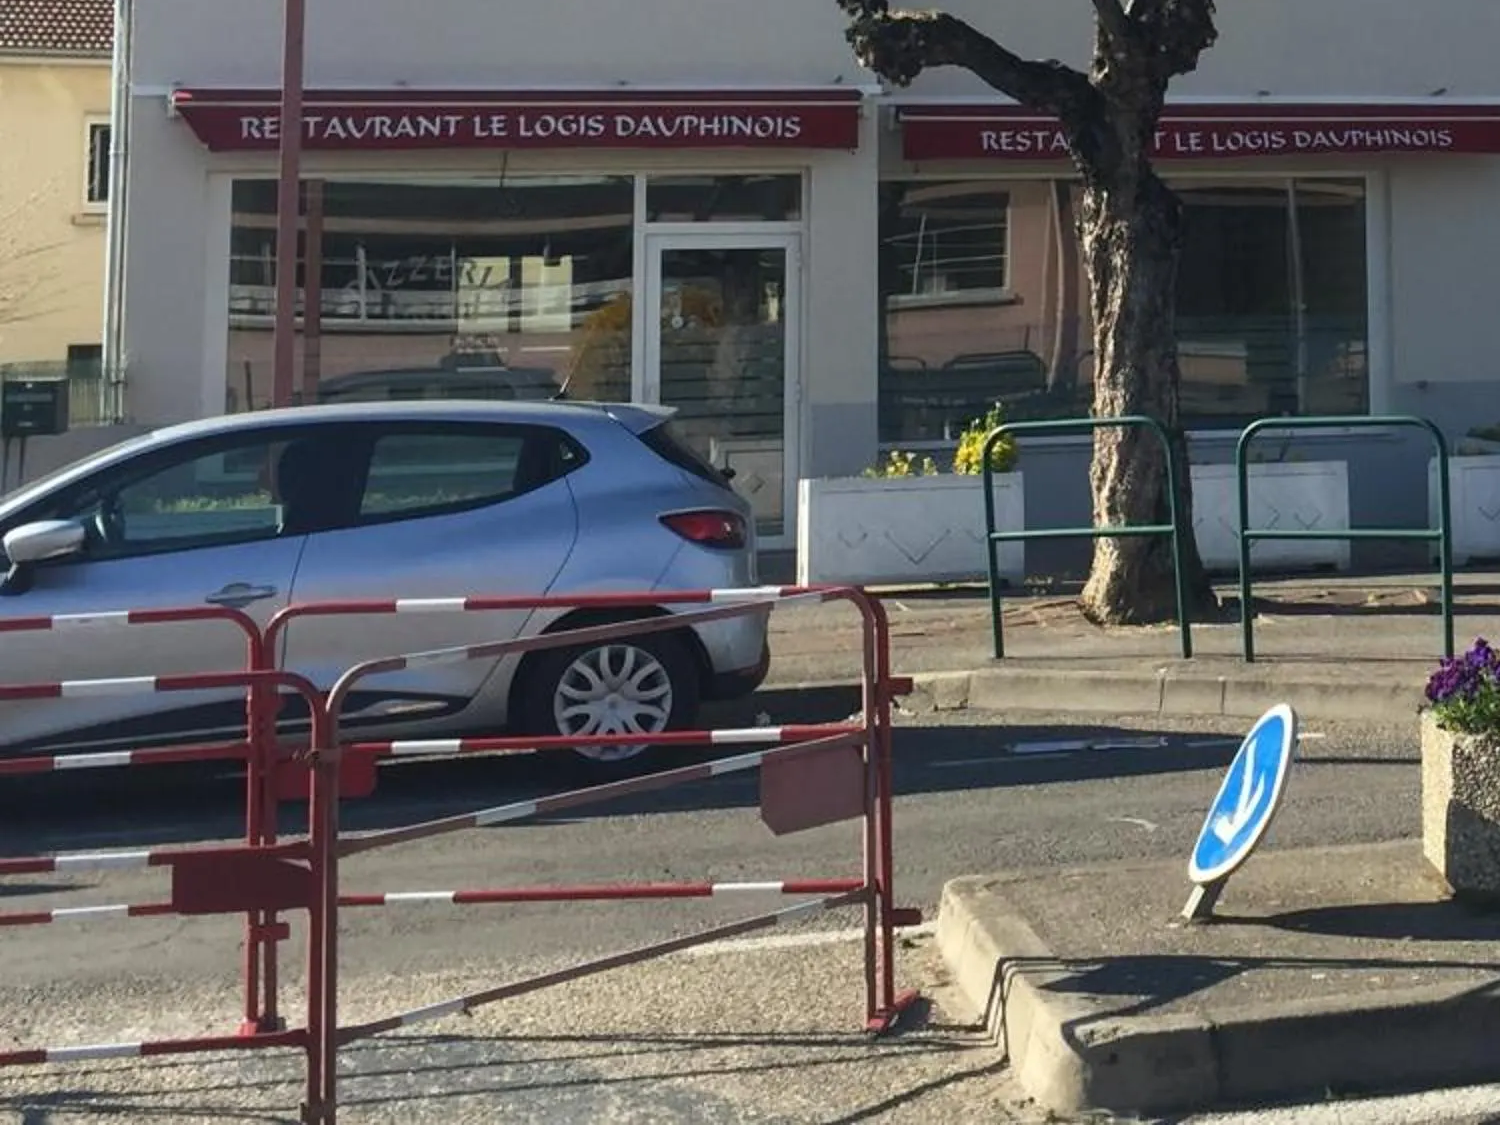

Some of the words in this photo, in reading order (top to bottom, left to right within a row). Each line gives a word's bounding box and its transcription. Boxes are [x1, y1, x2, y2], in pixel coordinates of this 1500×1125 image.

[240, 115, 464, 140] RETAURANT
[473, 115, 508, 137] LE
[518, 114, 605, 137] LOGIS
[613, 114, 802, 139] DAUPHINOIS
[981, 130, 1168, 152] RESTAT
[1175, 131, 1205, 152] LE
[1212, 130, 1287, 151] LOGIS
[1292, 129, 1453, 149] DAUPHINOIS
